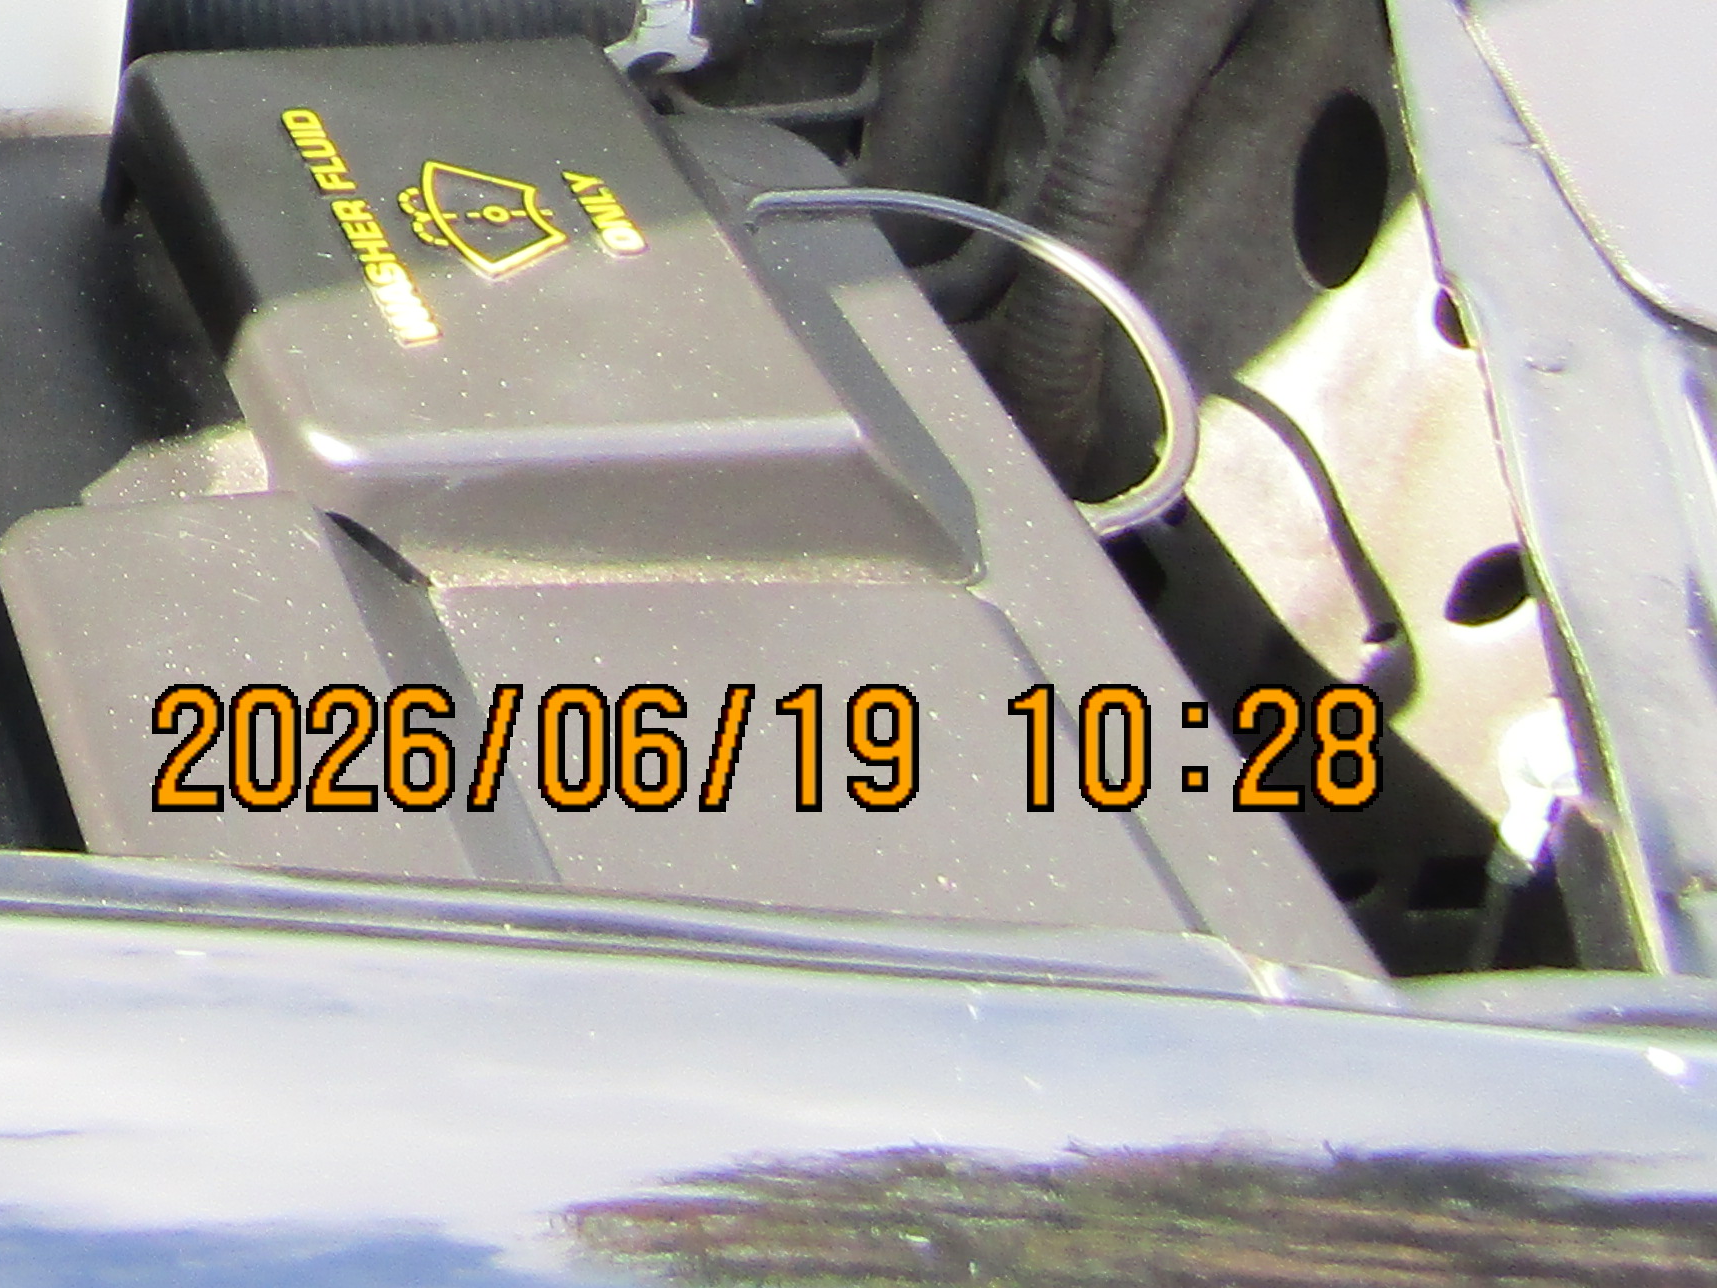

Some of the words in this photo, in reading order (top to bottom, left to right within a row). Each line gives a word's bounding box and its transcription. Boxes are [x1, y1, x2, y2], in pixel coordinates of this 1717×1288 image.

[280, 107, 357, 195] FLUID
[561, 168, 649, 257] ONLY
[330, 196, 444, 348] WASHER
